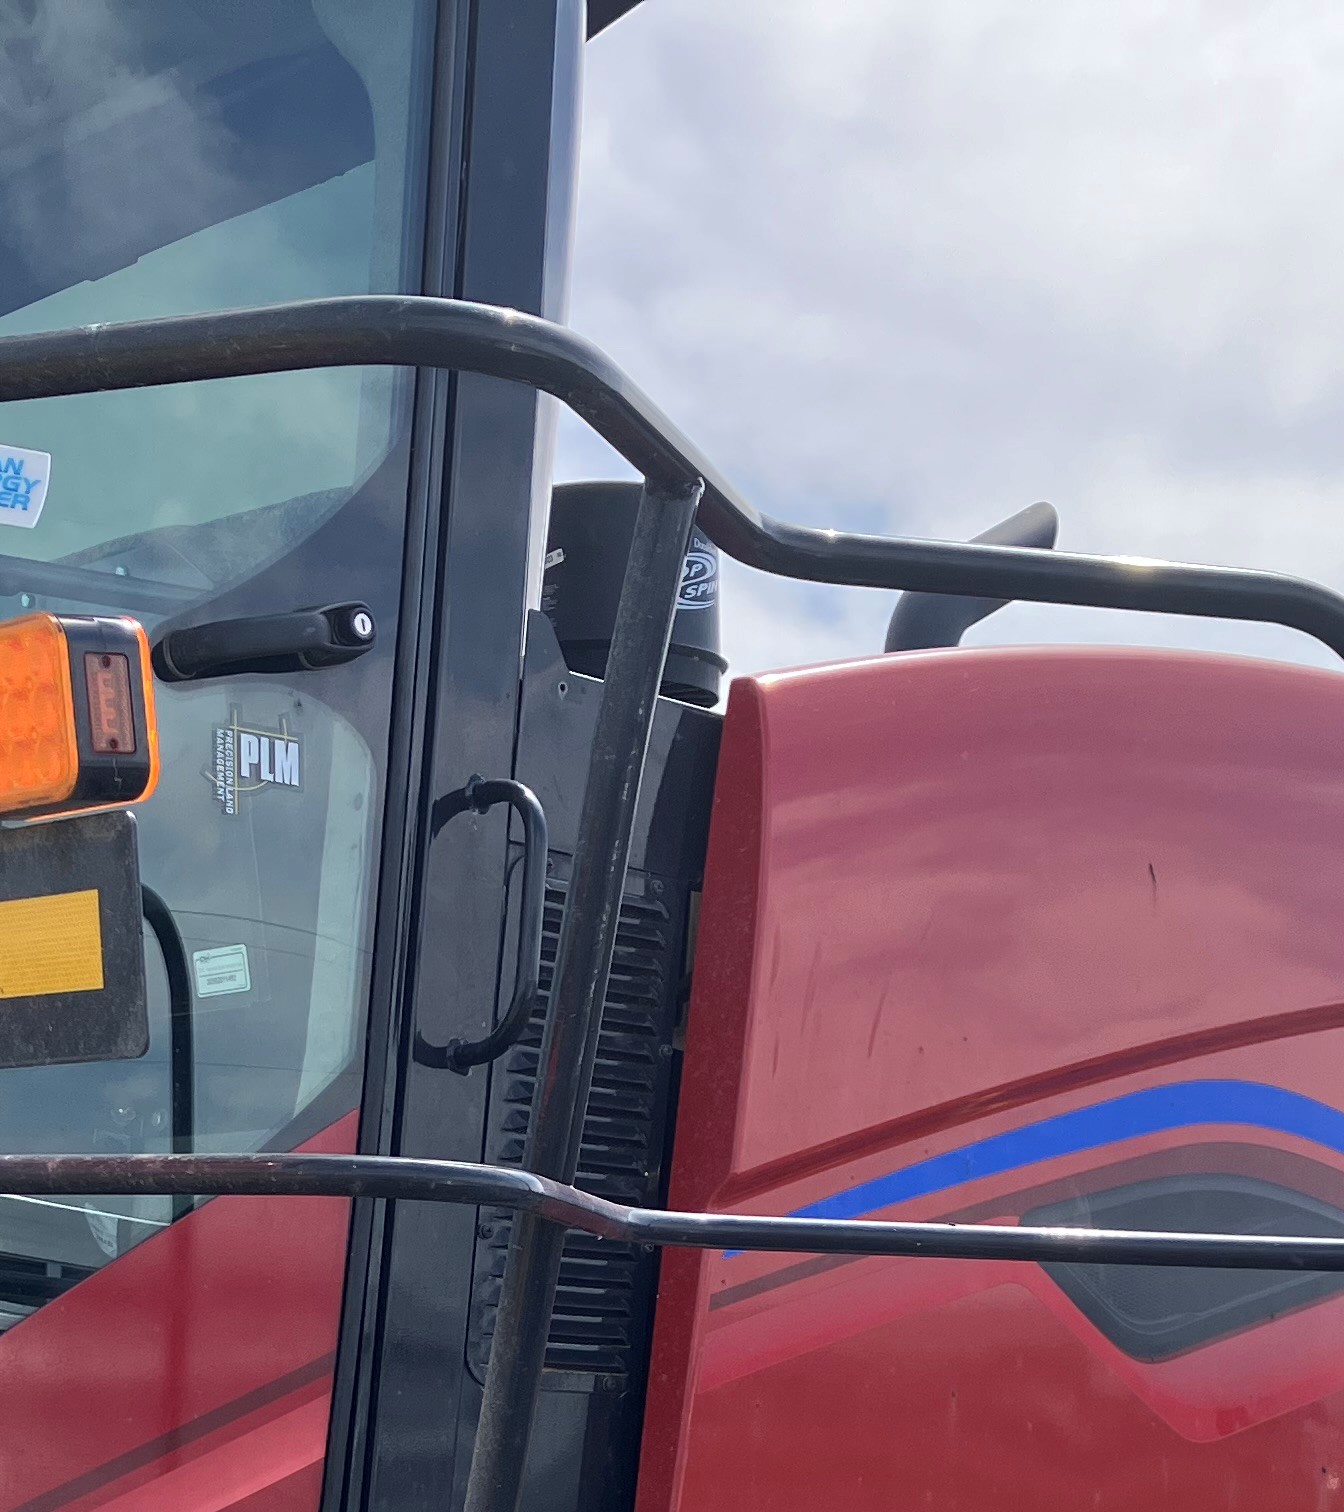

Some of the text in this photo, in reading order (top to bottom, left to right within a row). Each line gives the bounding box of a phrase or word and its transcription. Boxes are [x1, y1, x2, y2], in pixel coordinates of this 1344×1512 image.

[216, 728, 225, 802] MANAGEMENT
[225, 730, 234, 815] PRECISION LAND
[240, 732, 300, 787] PLM
